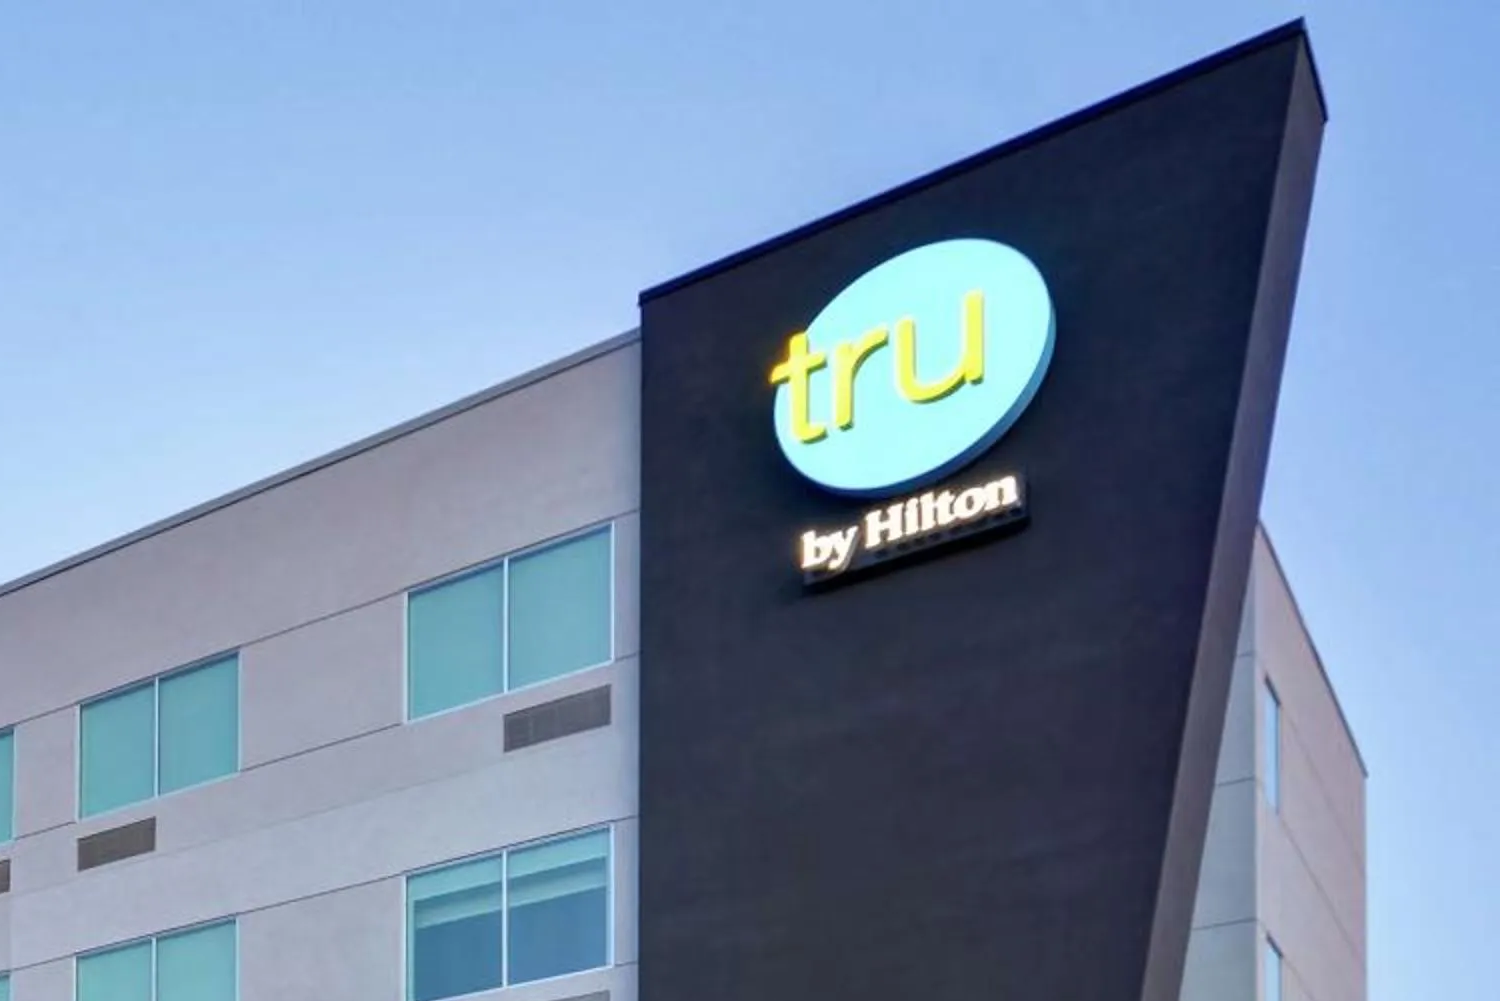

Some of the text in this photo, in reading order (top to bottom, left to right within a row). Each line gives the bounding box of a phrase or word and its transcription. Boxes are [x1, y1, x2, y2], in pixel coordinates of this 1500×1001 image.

[768, 288, 985, 443] tru
[801, 475, 1018, 570] by Hilton
